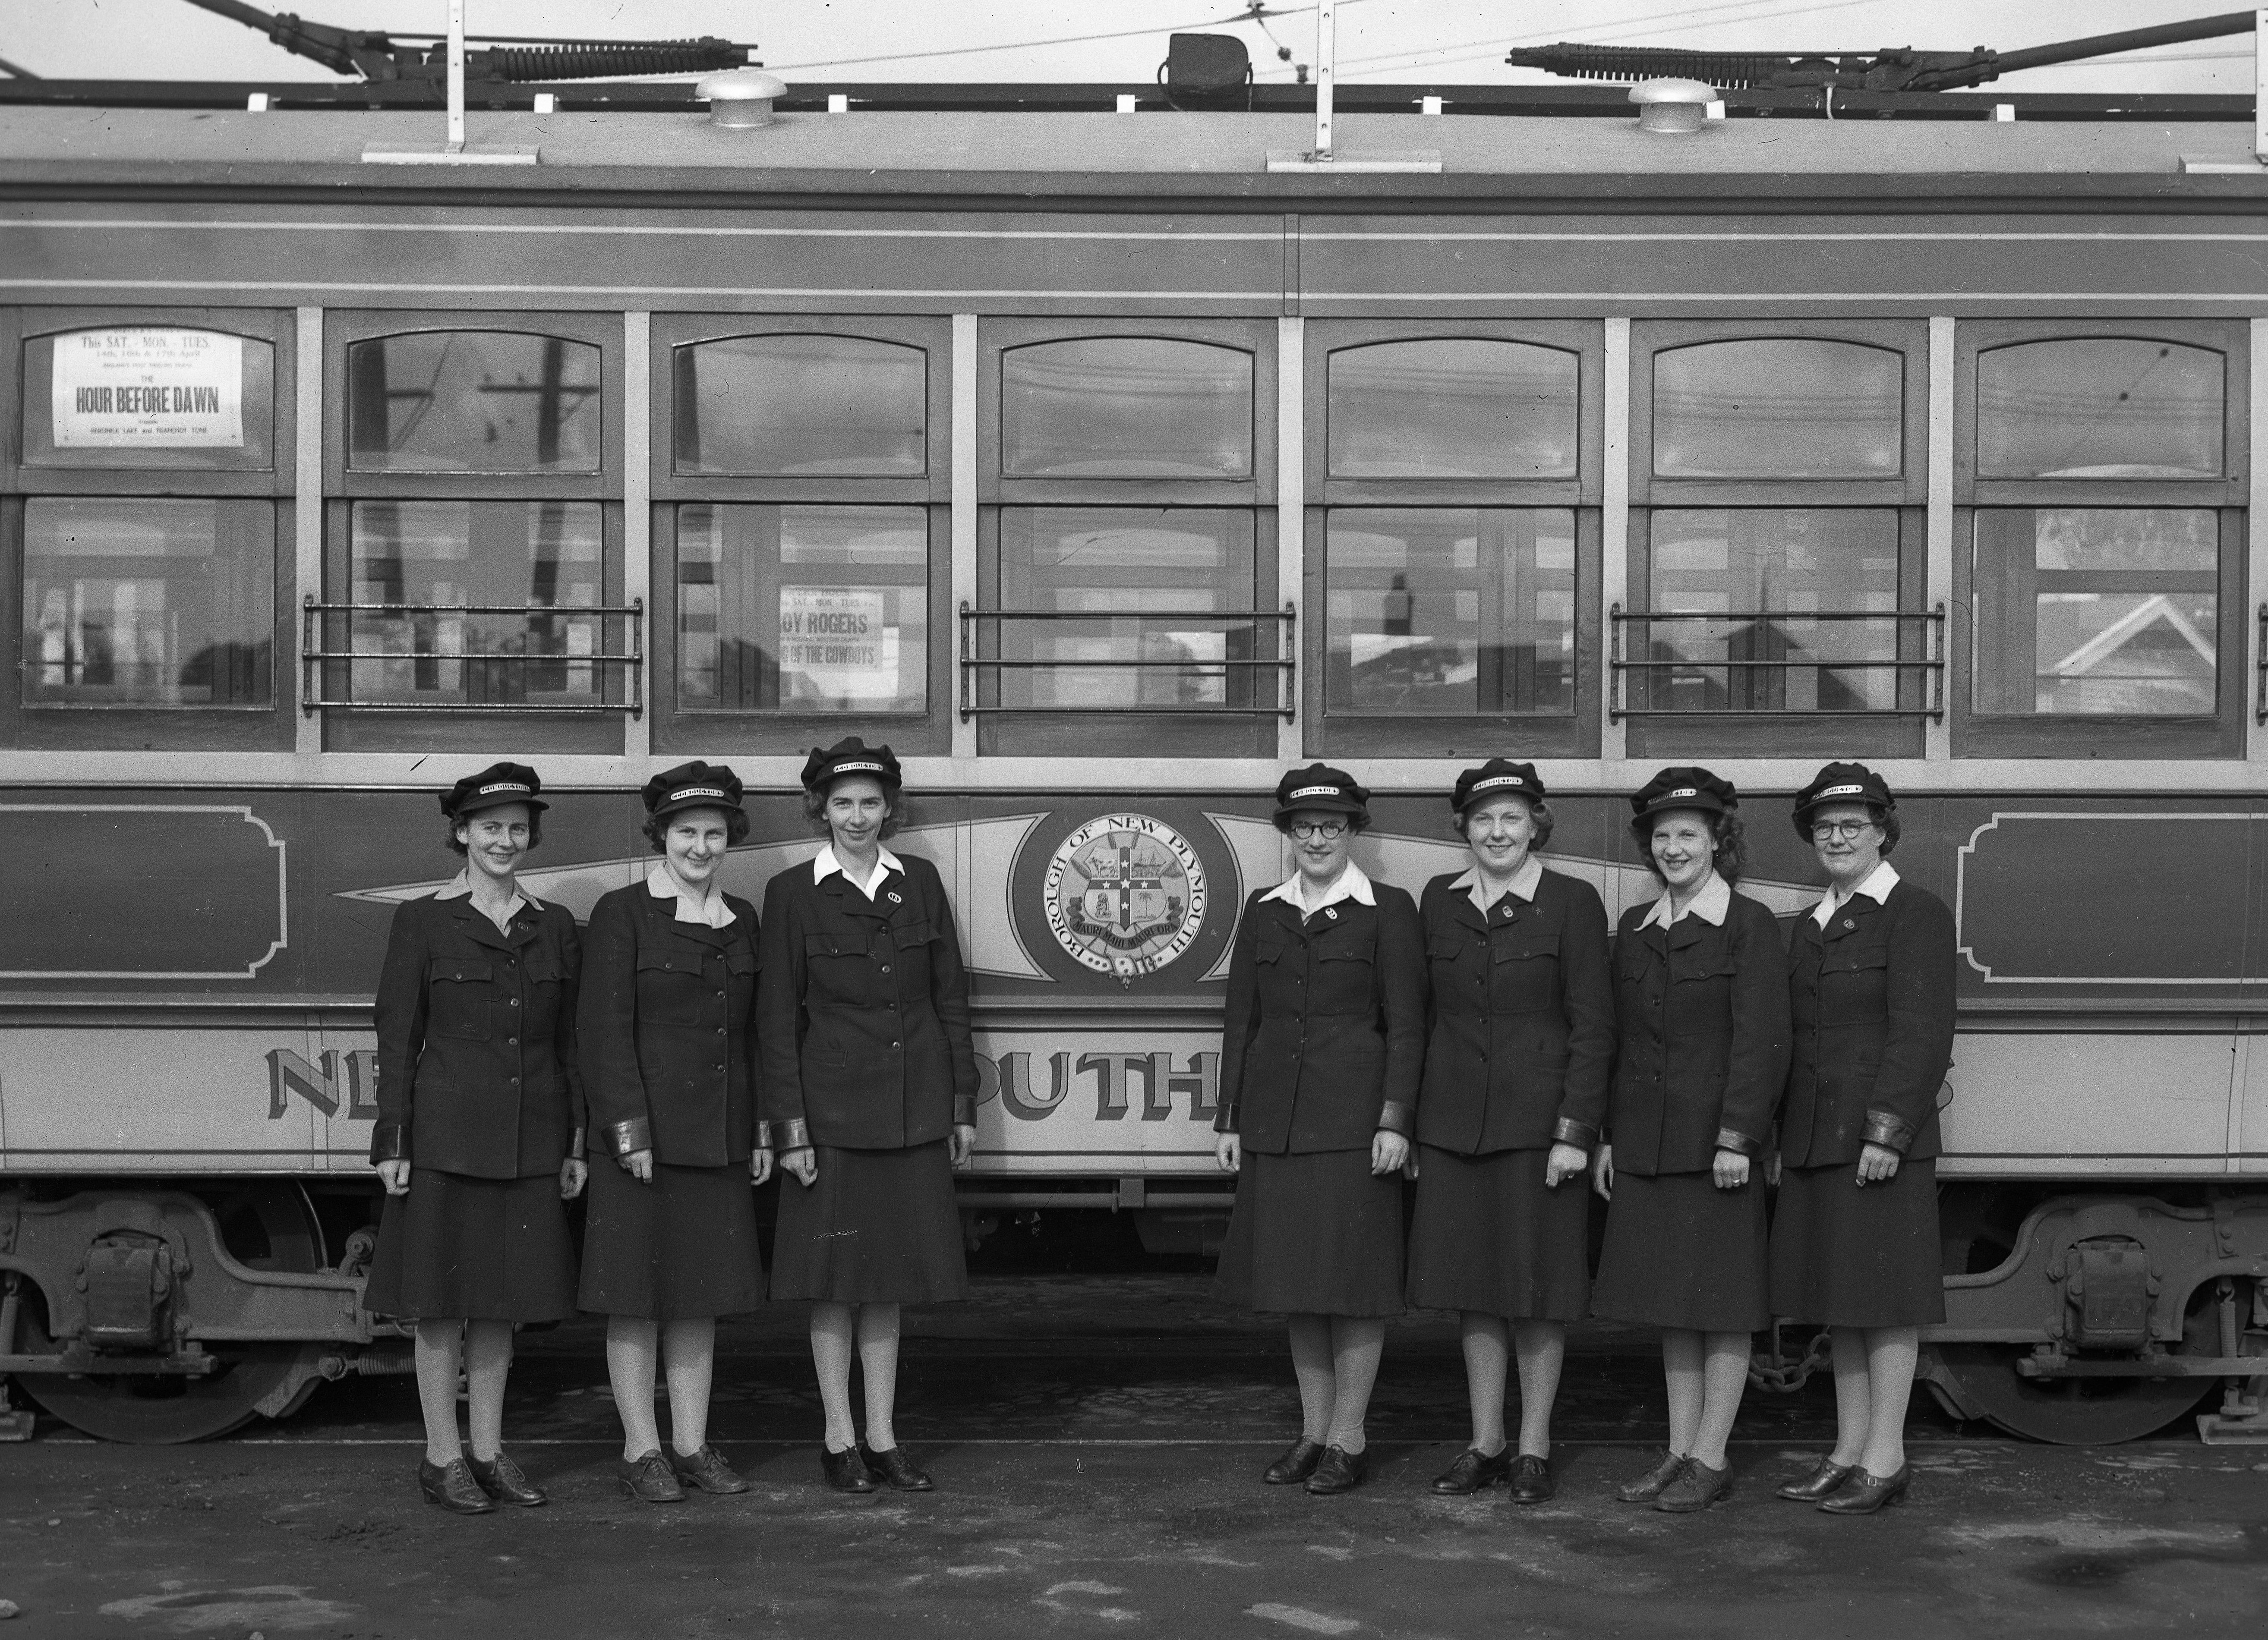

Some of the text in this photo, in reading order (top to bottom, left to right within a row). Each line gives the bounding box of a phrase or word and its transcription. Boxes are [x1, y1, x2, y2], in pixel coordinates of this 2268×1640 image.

[76, 386, 219, 413] HOUR BEFORE DAWN
[782, 612, 867, 634] OY ROGERS
[805, 645, 823, 664] THE
[825, 645, 875, 664] COWBOYS
[1047, 817, 1204, 957] BOROUGH OF NEW PLYMOUTH
[1073, 921, 1179, 948] MAURI MAHI MAURI ORA
[265, 1049, 379, 1120] NE
